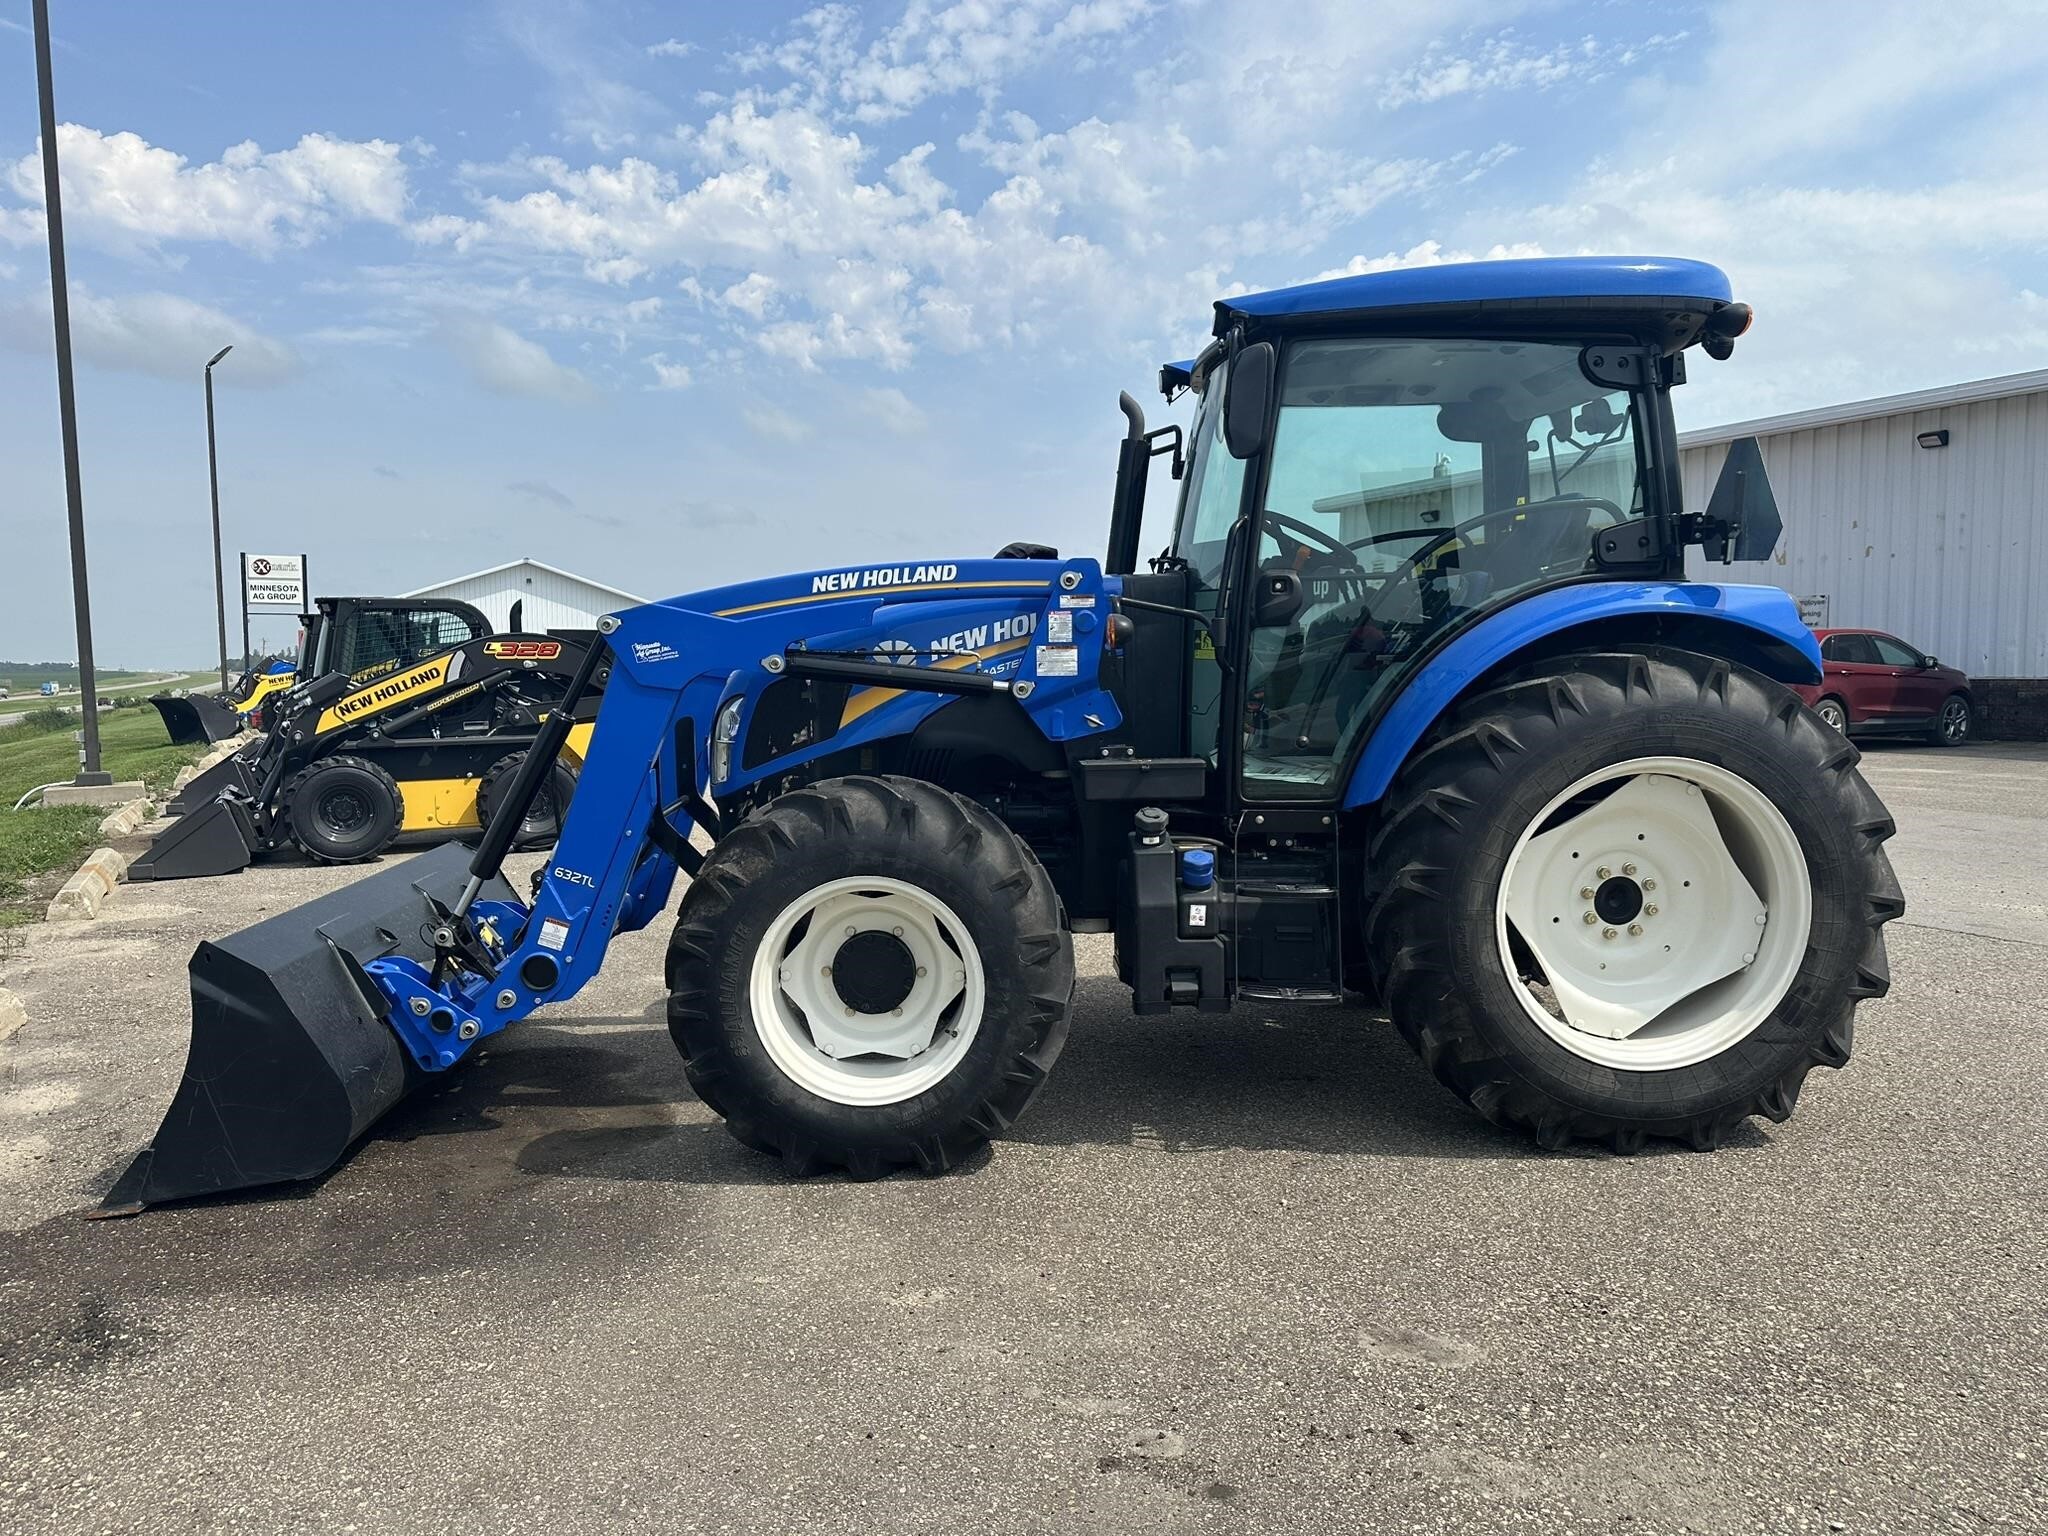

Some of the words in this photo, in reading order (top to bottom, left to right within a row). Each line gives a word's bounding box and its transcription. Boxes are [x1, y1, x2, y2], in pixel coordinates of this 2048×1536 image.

[250, 584, 299, 592] MINNESOTA
[812, 571, 860, 593] NEW
[862, 564, 957, 587] HOLLAND
[484, 642, 561, 659] L328
[931, 625, 988, 662] NEW
[984, 659, 1022, 675] ASTE
[338, 694, 372, 716] NEW
[375, 667, 441, 702] HOLLAND
[554, 866, 595, 888] 632TL
